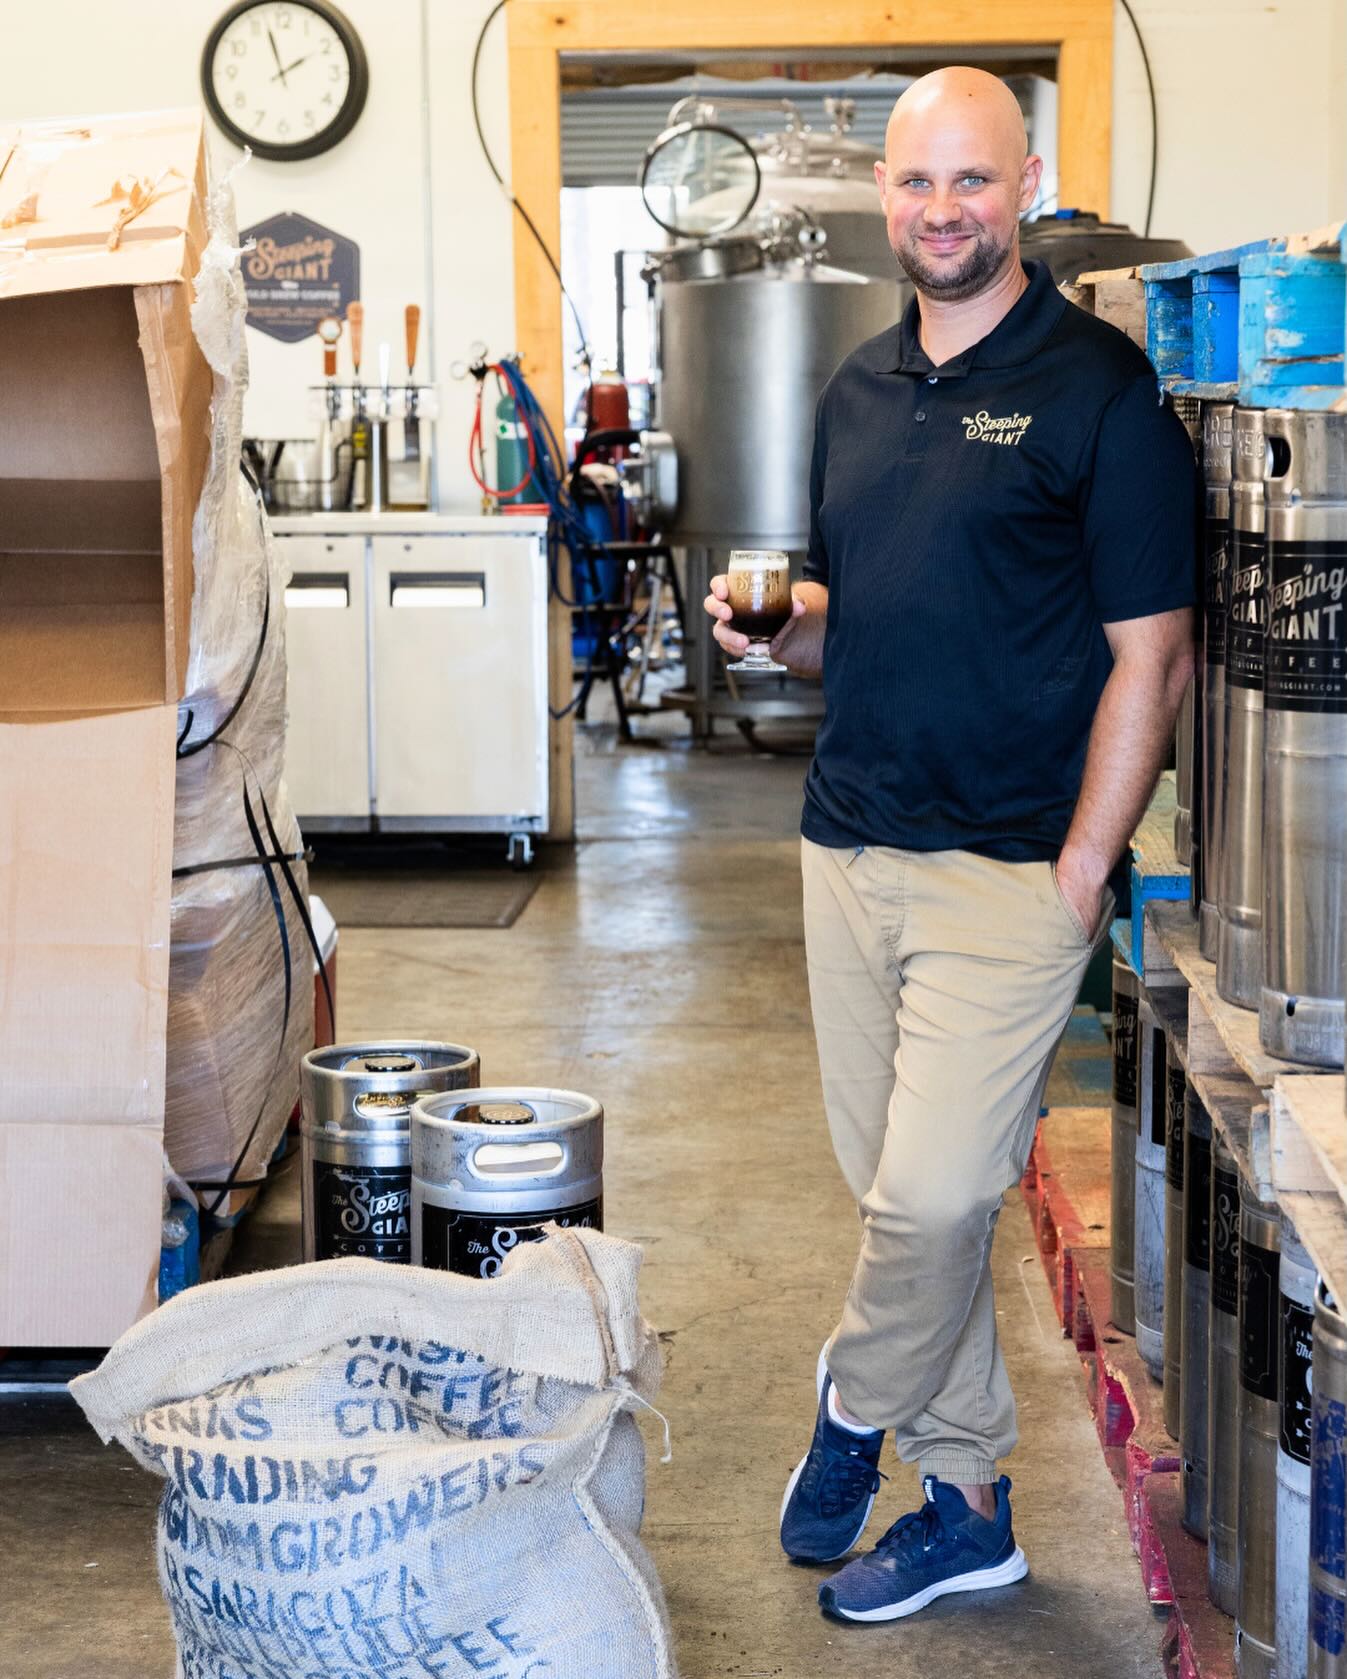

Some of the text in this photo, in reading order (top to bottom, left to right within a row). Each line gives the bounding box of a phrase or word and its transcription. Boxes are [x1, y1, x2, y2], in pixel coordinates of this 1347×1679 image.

[275, 11, 291, 29] 12
[231, 40, 246, 56] 10
[321, 38, 331, 54] 2
[226, 65, 237, 80] 9
[329, 64, 340, 82] 3
[234, 91, 246, 108] 8
[321, 91, 332, 105] 4
[256, 109, 265, 126] 7
[278, 117, 289, 135] 6
[304, 110, 314, 127] 5
[274, 259, 331, 280] GIANT
[966, 410, 1033, 440] Steeping
[981, 431, 1026, 446] GIANT
[1264, 563, 1347, 637] teeping
[1271, 603, 1343, 641] GIANT
[467, 1240, 490, 1254] The
